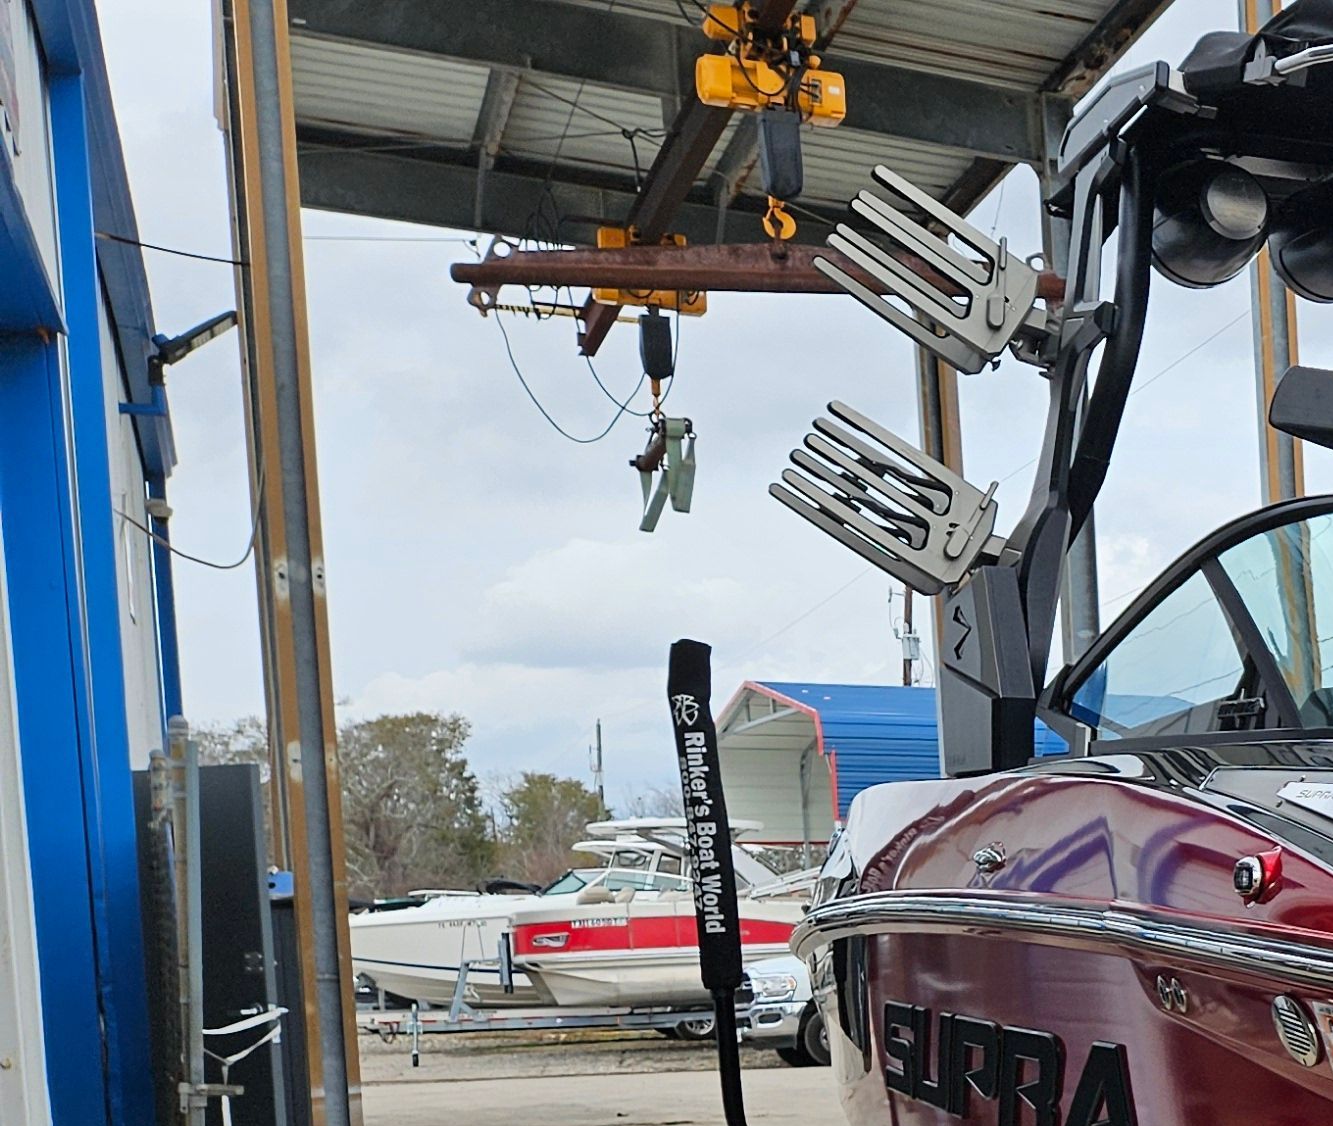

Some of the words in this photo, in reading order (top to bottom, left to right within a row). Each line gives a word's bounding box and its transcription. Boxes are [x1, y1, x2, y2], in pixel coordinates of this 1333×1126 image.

[684, 732, 713, 817] Rinker's
[696, 822, 720, 870] Boat
[701, 874, 727, 934] World
